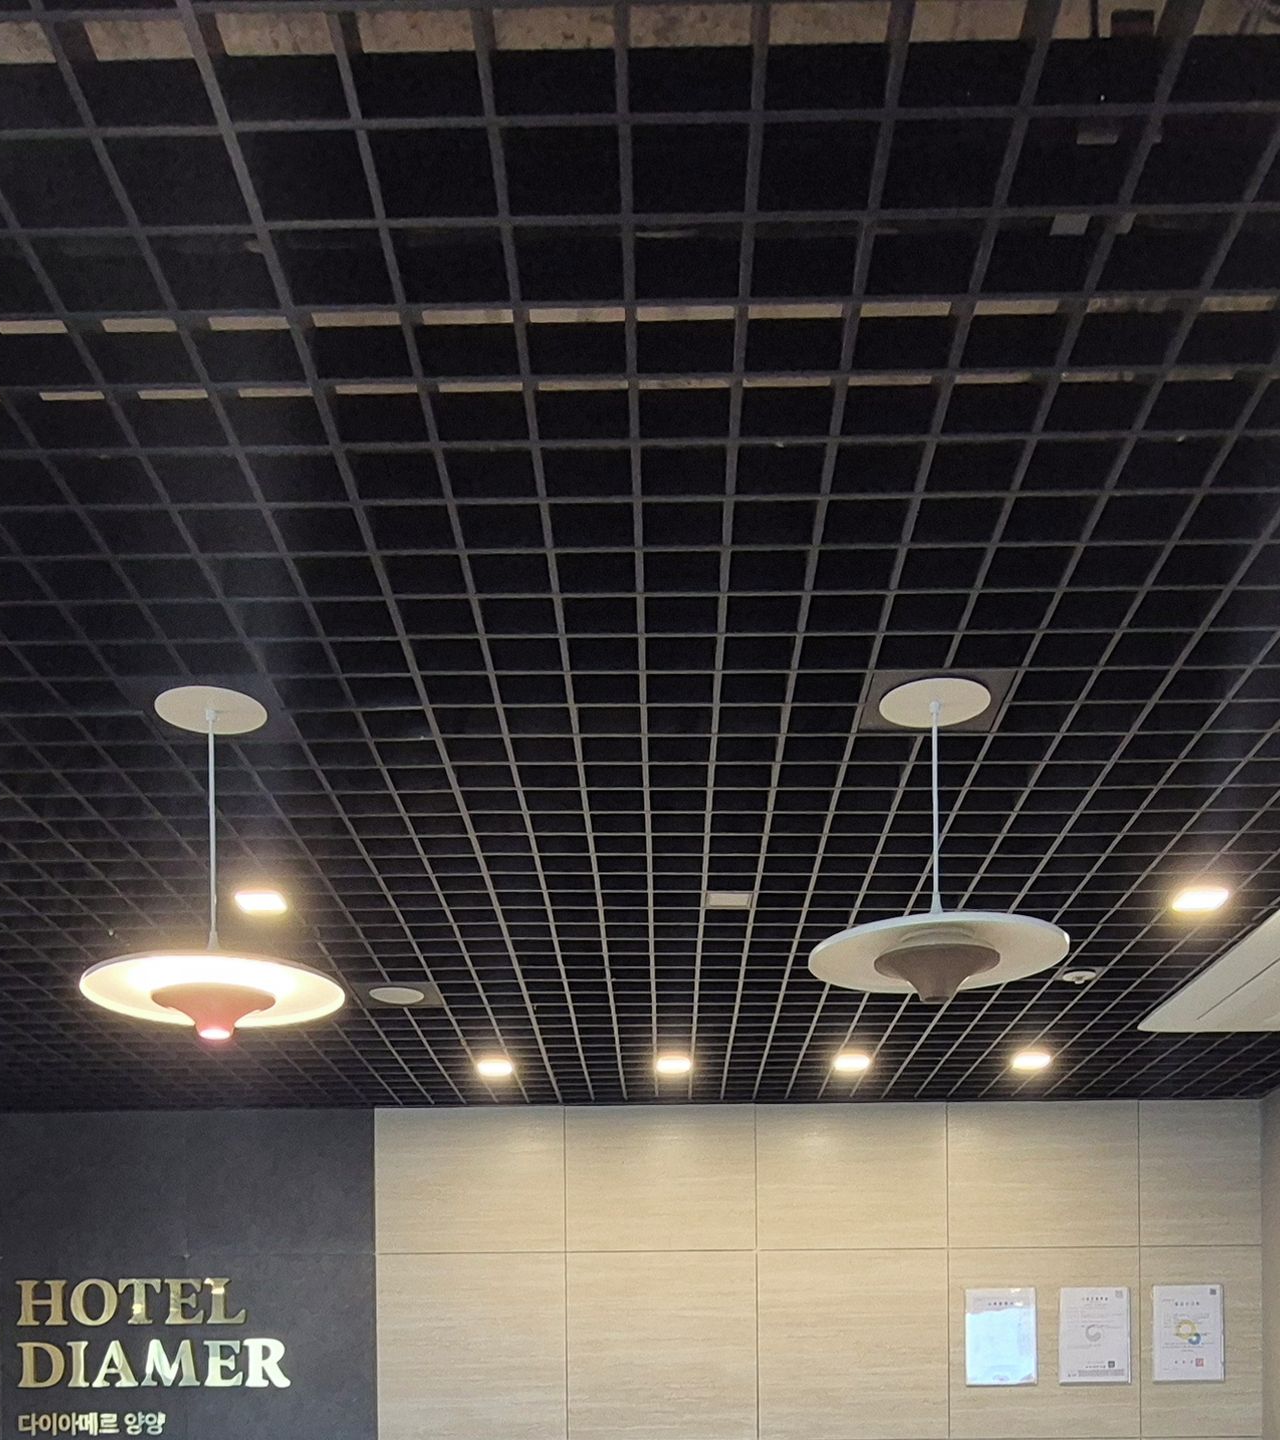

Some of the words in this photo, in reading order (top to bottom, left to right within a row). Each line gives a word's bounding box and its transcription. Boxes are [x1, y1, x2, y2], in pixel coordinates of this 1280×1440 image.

[17, 1277, 247, 1327] HOTEL
[17, 1338, 291, 1390] DIAMER
[18, 1412, 120, 1437] 다이아메르
[124, 1411, 167, 1436] 양양
